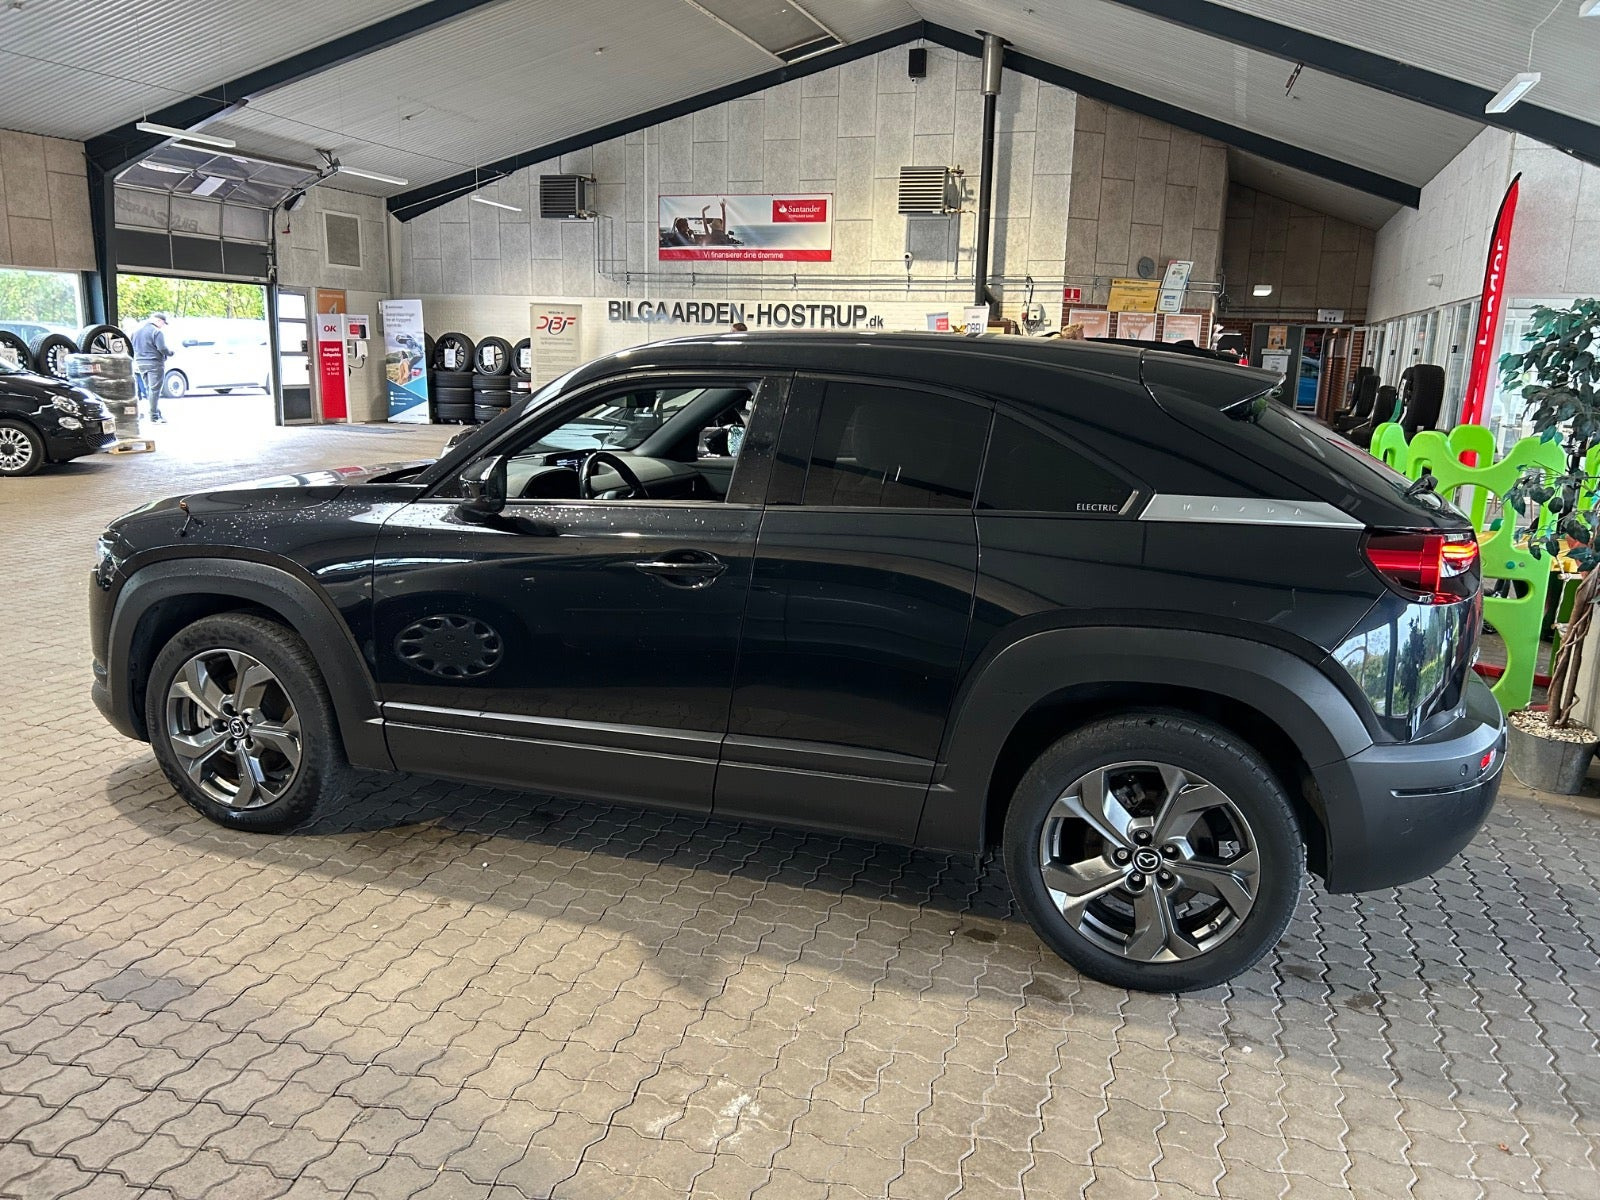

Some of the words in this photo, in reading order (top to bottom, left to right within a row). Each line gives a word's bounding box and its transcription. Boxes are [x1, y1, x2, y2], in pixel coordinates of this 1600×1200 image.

[788, 205, 821, 213] Santander
[743, 251, 757, 259] dine
[1076, 503, 1118, 512] ELECTRIC
